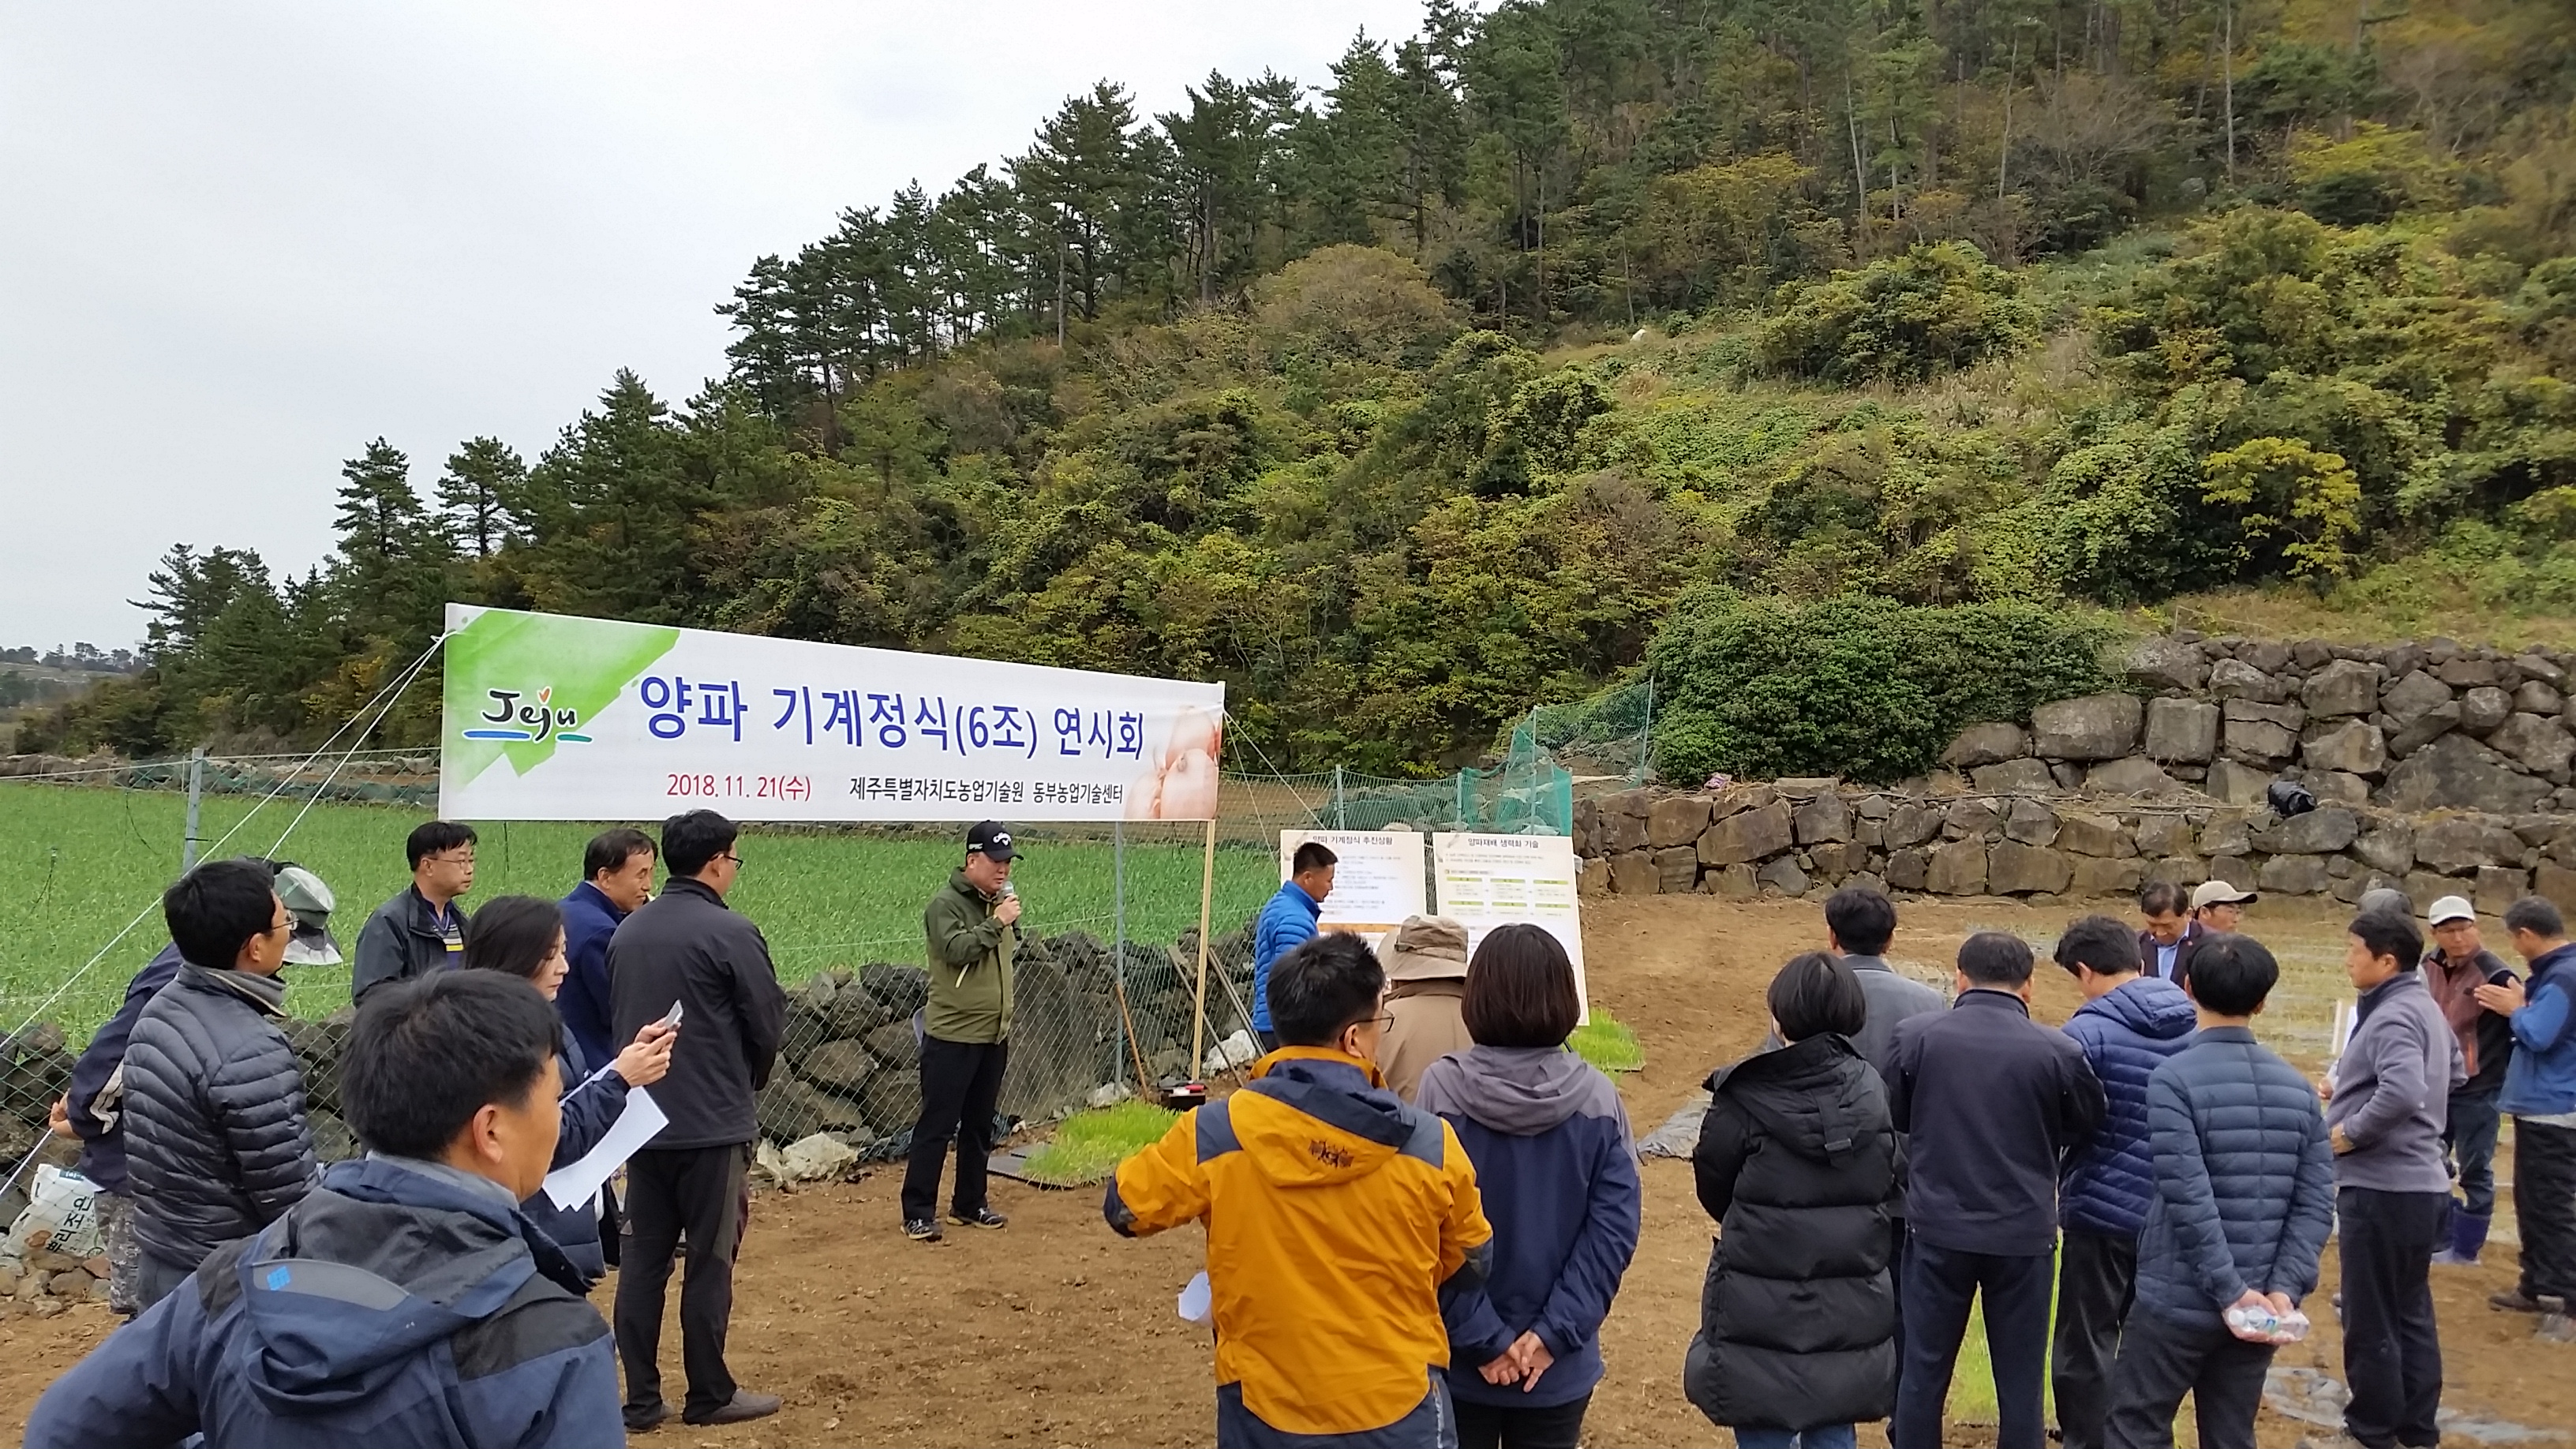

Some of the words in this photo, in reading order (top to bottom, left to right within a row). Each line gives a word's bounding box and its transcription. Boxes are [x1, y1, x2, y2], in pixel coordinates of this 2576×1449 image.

[481, 687, 578, 742] Jeju
[640, 676, 749, 743] 양파
[773, 686, 1038, 759] 기계정식(6조)
[1054, 707, 1145, 760] 연시회
[666, 773, 719, 799] 2018.
[724, 776, 751, 799] 11.
[757, 776, 811, 803] 21(수)
[849, 776, 1024, 803] 제주특별자치도농업기술원
[1032, 781, 1124, 804] 동부농업기술센터
